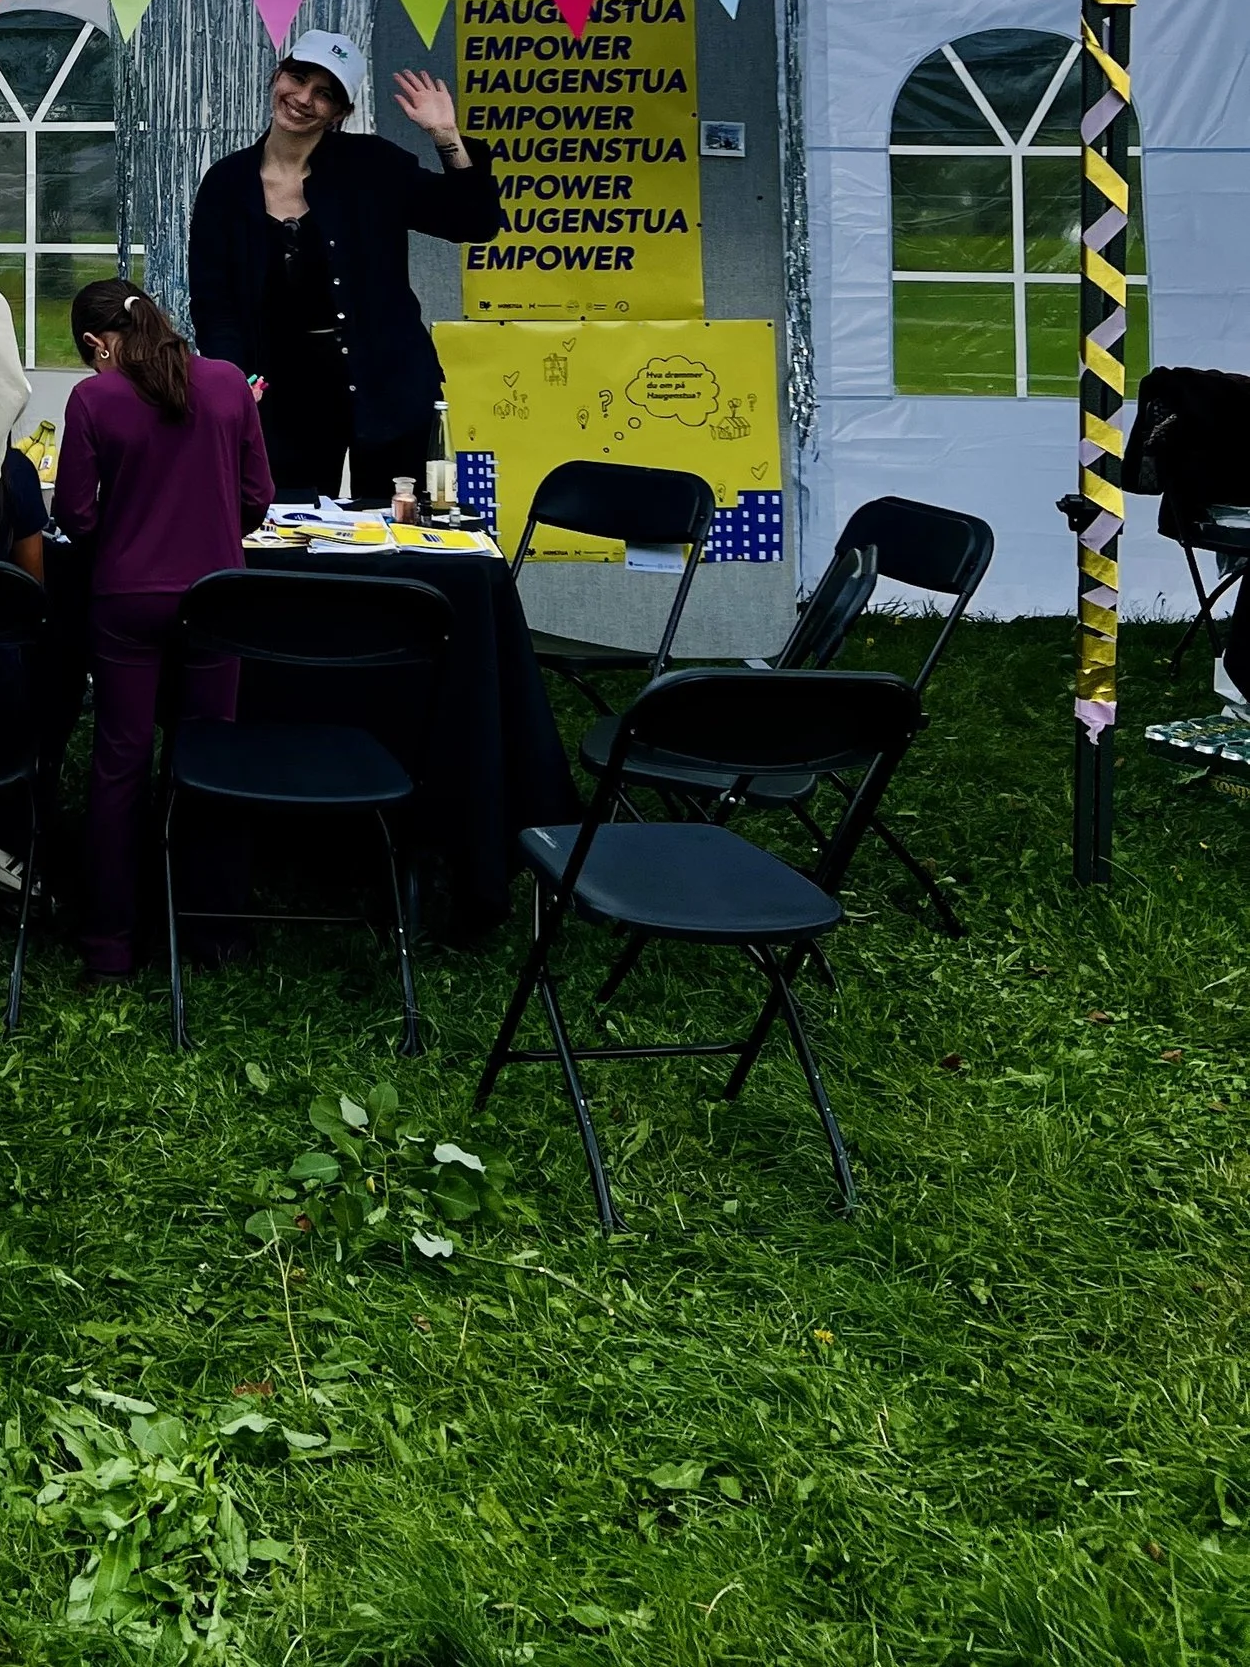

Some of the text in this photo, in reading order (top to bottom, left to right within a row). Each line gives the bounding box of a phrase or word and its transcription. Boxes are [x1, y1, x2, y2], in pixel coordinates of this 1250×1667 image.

[464, 0, 685, 24] HAUGNSTUA
[465, 36, 632, 60] EMPOWER
[465, 69, 687, 94] HAUGENSTUA
[466, 106, 634, 130] EMPOWER
[489, 138, 687, 162] AUGENSTUA
[491, 175, 633, 200] MPOWER
[499, 209, 689, 233] AUGENSTUA
[467, 246, 635, 270] EMPOWER
